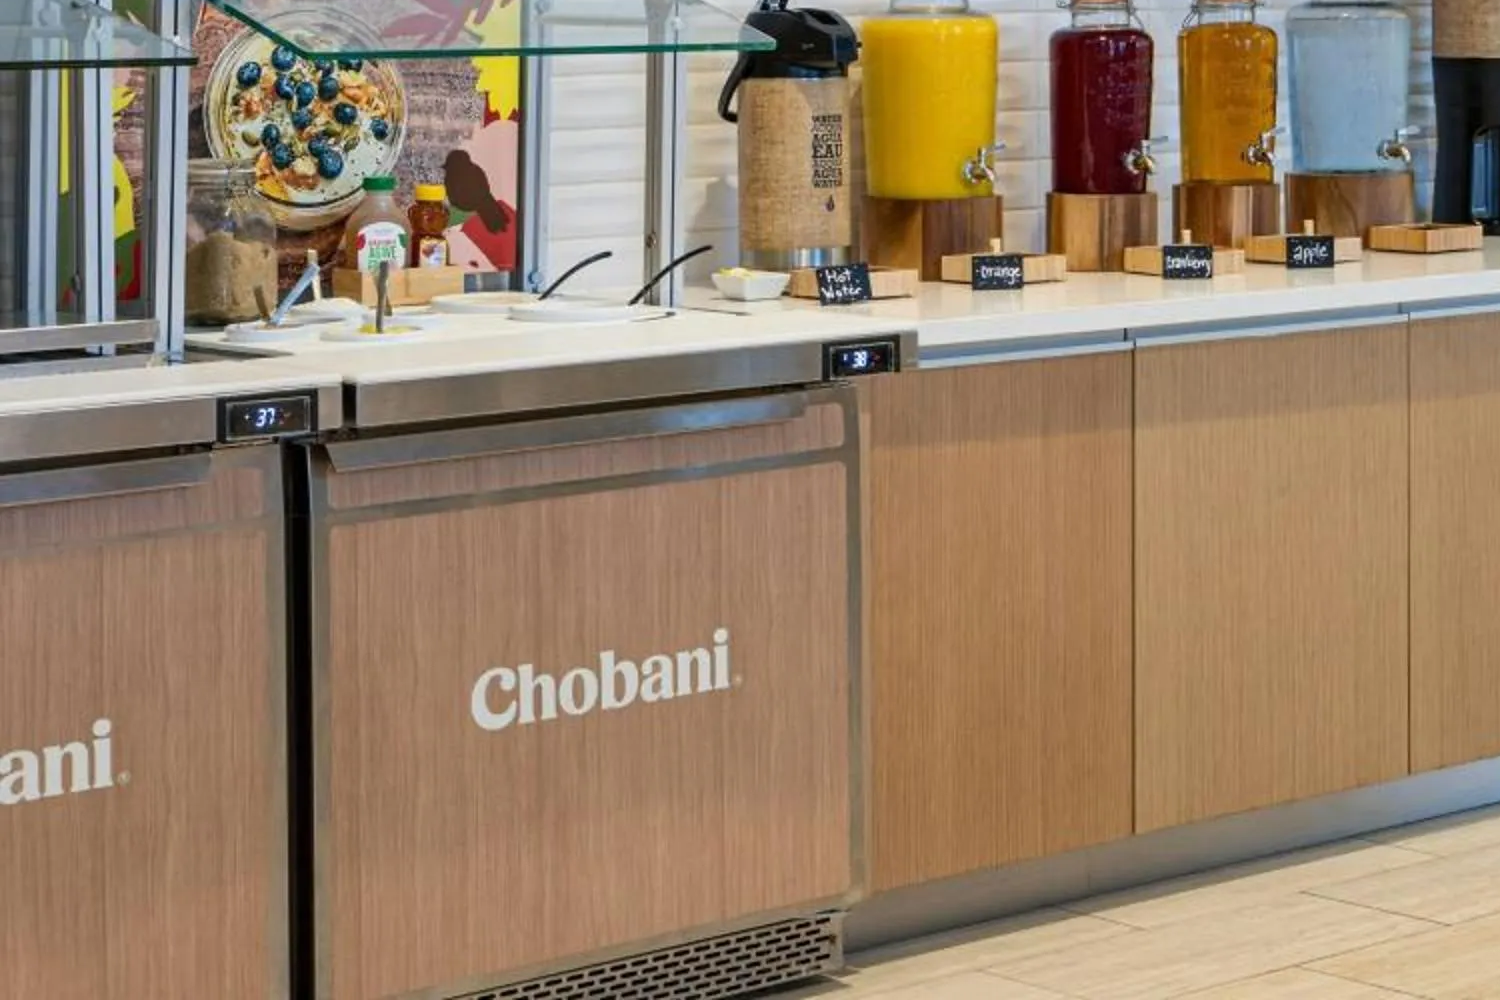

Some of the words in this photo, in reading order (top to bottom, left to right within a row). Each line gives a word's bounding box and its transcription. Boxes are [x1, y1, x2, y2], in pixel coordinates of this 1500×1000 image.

[811, 143, 843, 158] EAU
[825, 268, 851, 283] Hot
[851, 351, 868, 369] 38
[255, 407, 276, 428] 37
[470, 627, 731, 731] Chobani
